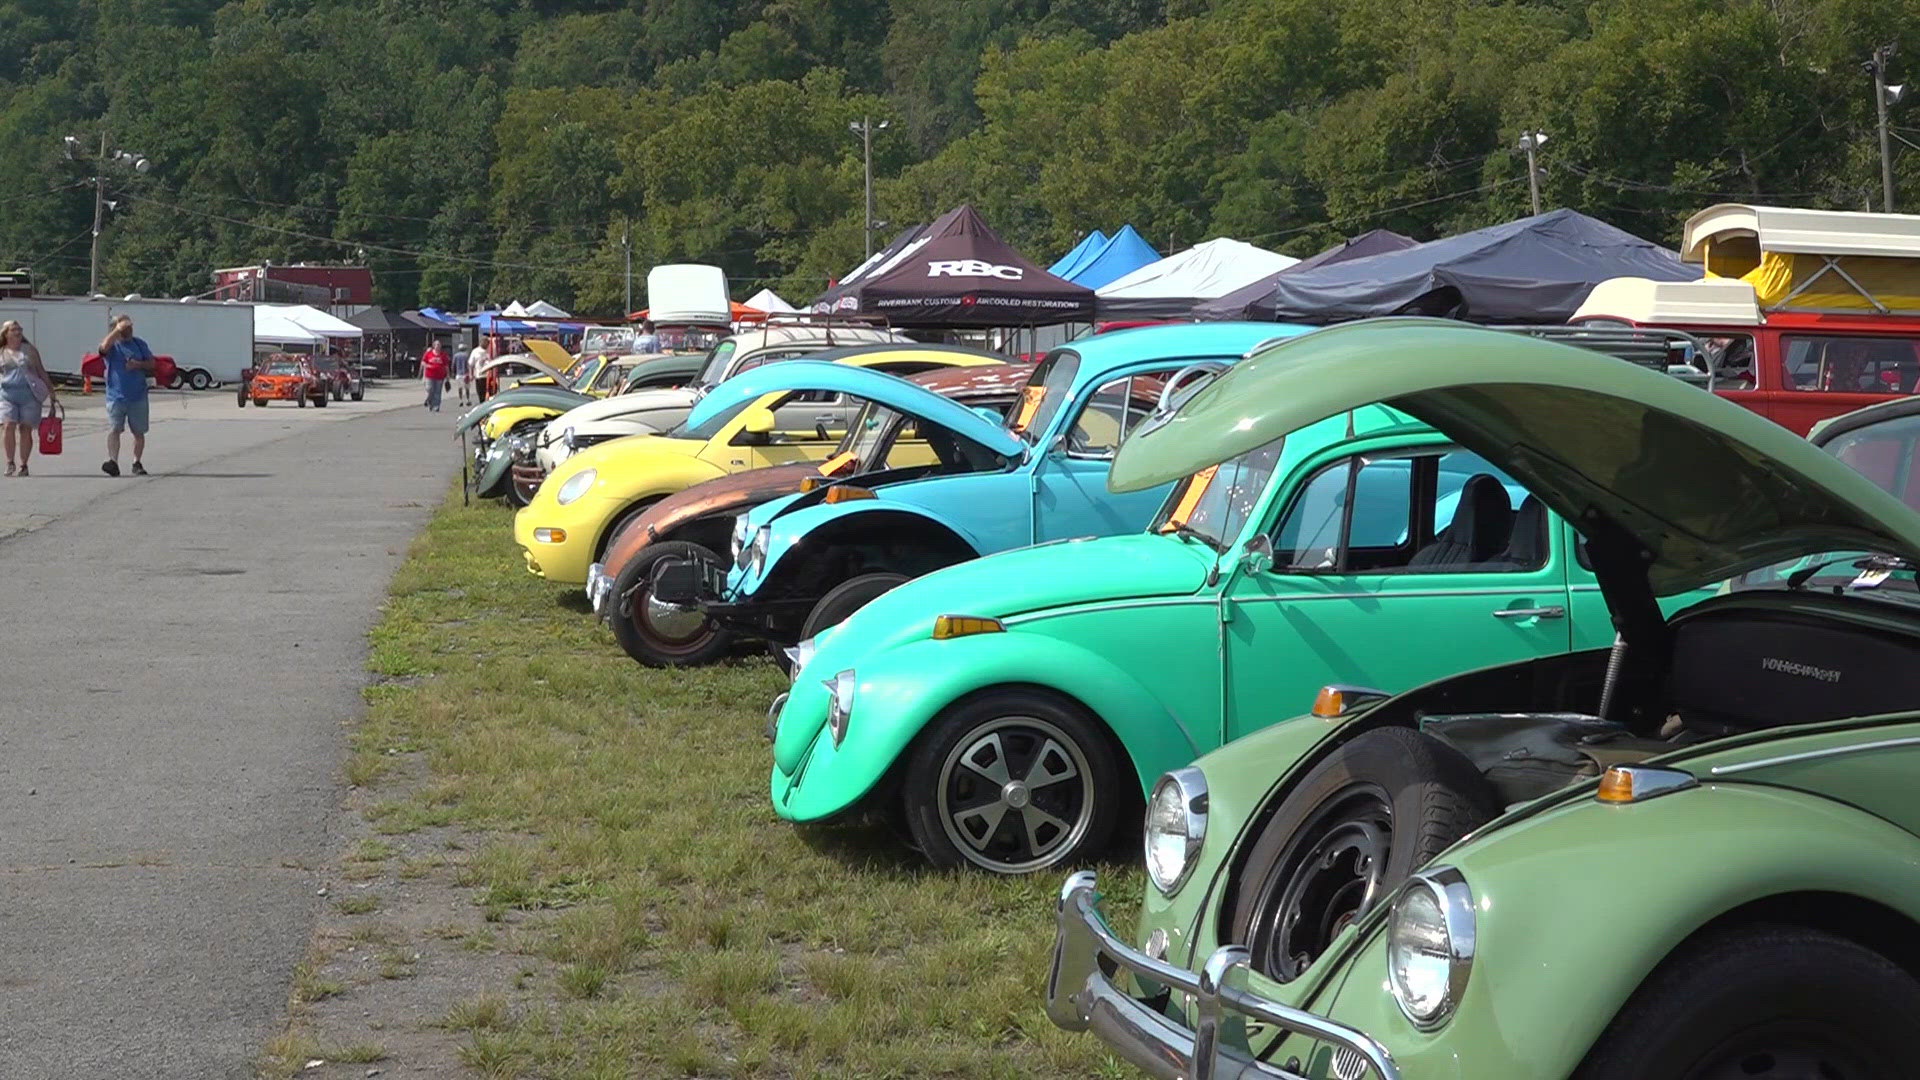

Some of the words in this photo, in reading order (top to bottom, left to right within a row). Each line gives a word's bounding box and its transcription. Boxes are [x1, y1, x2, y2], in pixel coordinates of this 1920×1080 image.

[927, 259, 1024, 281] RBC
[878, 298, 922, 307] RIVERBANK
[923, 297, 961, 306] CUSTOMS
[976, 297, 1020, 306] AIRCOOLED
[1021, 300, 1080, 309] RESTORATIONS
